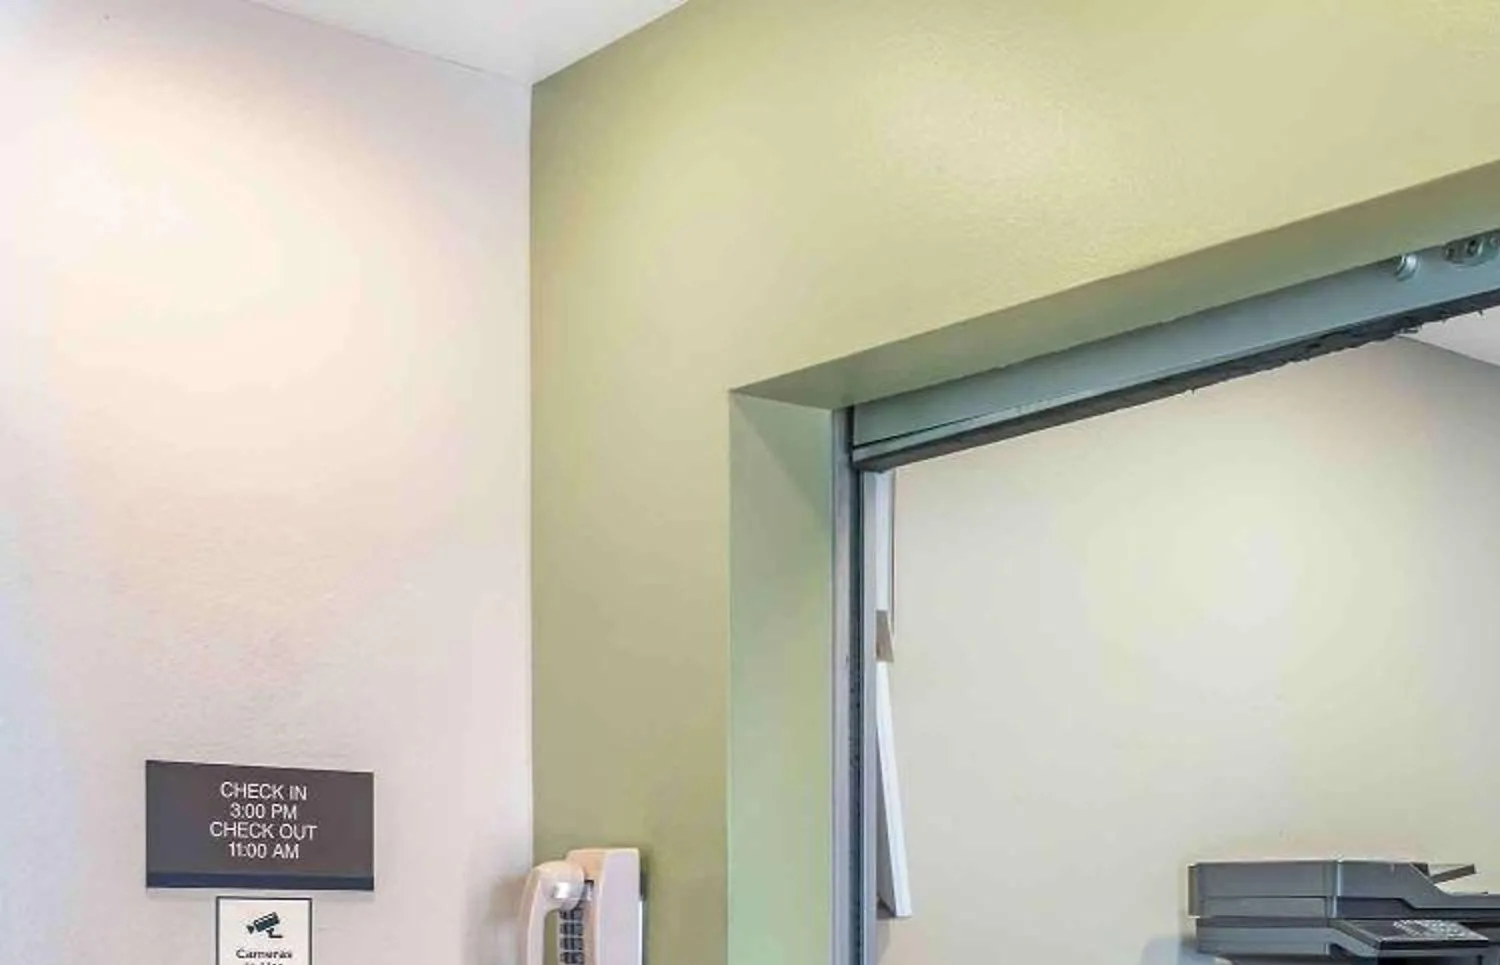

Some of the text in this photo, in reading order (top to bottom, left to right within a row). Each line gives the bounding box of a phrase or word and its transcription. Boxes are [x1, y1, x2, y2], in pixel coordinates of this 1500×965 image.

[220, 781, 307, 801] CHECK IN
[229, 802, 297, 820] 3:00 PM
[209, 821, 318, 841] CHECK OUT
[228, 841, 300, 860] 11:00 AM
[235, 948, 293, 959] Cameras
